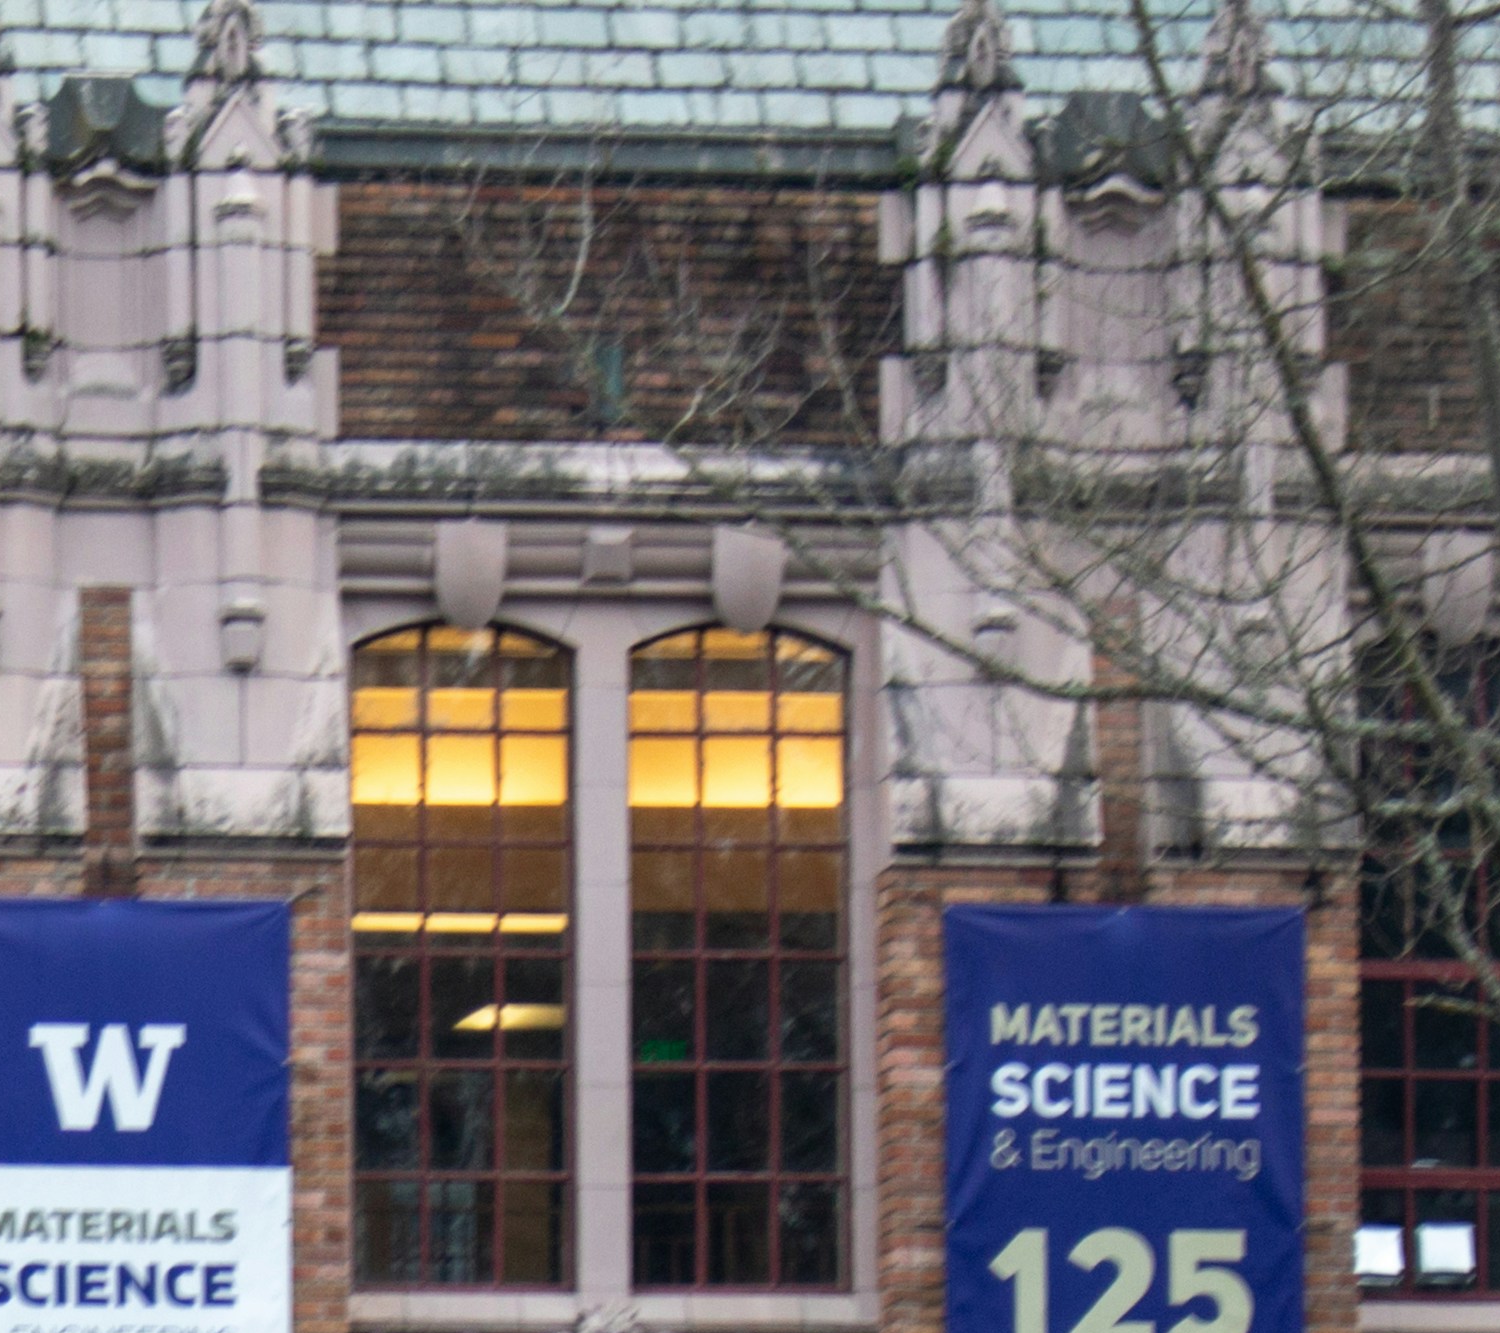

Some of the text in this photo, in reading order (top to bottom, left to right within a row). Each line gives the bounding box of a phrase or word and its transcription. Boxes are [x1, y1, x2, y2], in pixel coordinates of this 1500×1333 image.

[990, 1002, 1260, 1047] MATERIALS
[28, 1022, 186, 1132] W
[990, 1061, 1261, 1120] SCIENCE
[990, 1127, 1262, 1181] & Engineering
